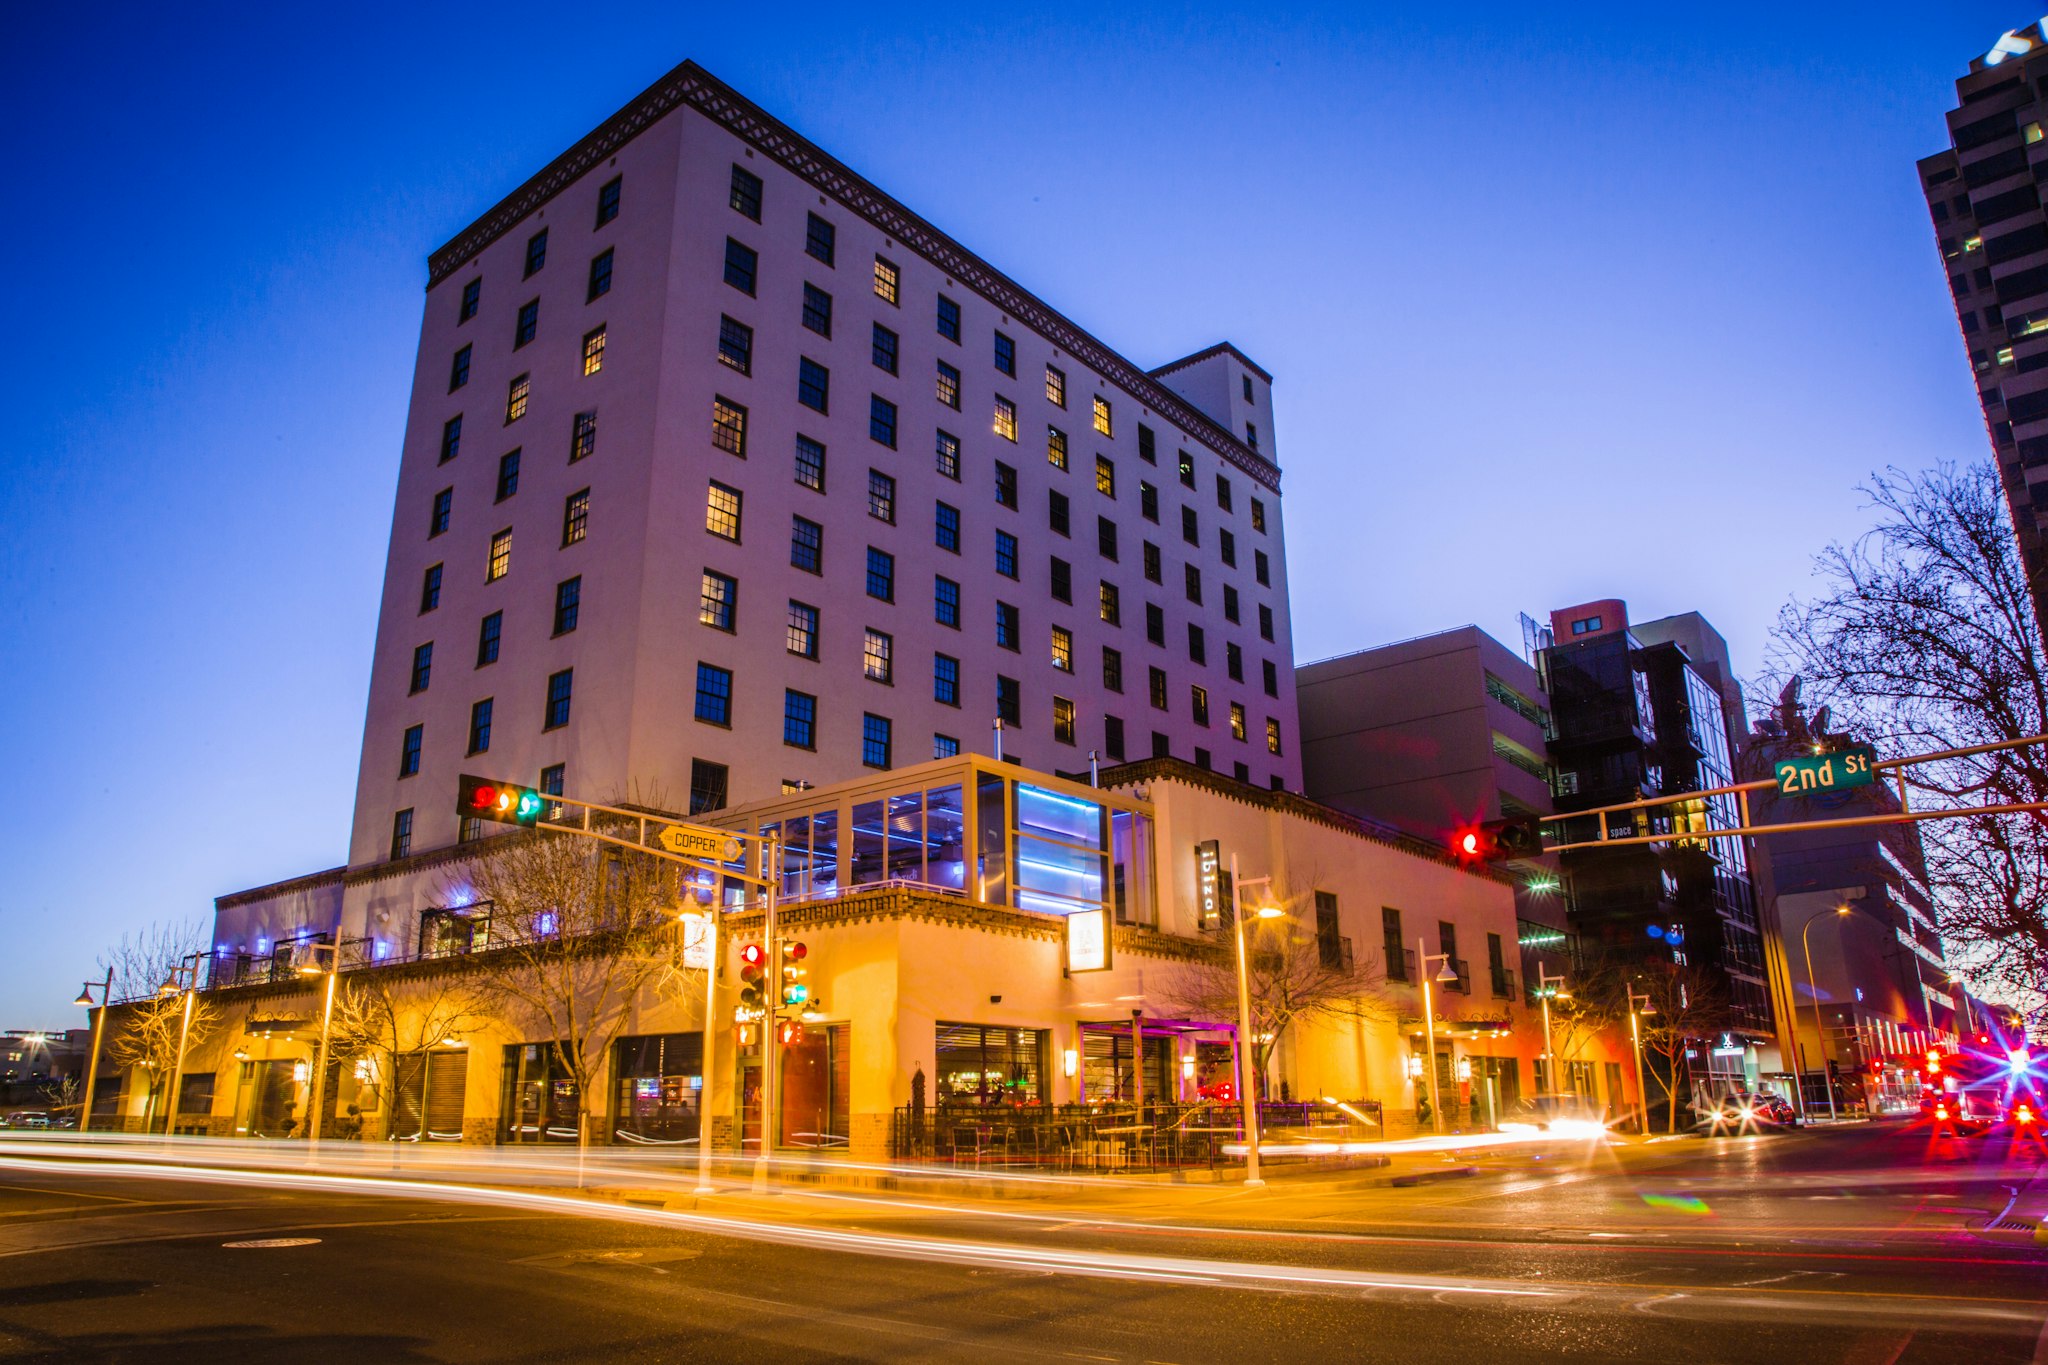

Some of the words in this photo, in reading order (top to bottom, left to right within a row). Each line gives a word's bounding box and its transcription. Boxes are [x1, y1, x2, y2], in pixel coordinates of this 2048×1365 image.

[1780, 759, 1834, 793] 2nd
[1845, 754, 1868, 774] St
[675, 832, 717, 853] COPPER
[1610, 826, 1632, 838] space
